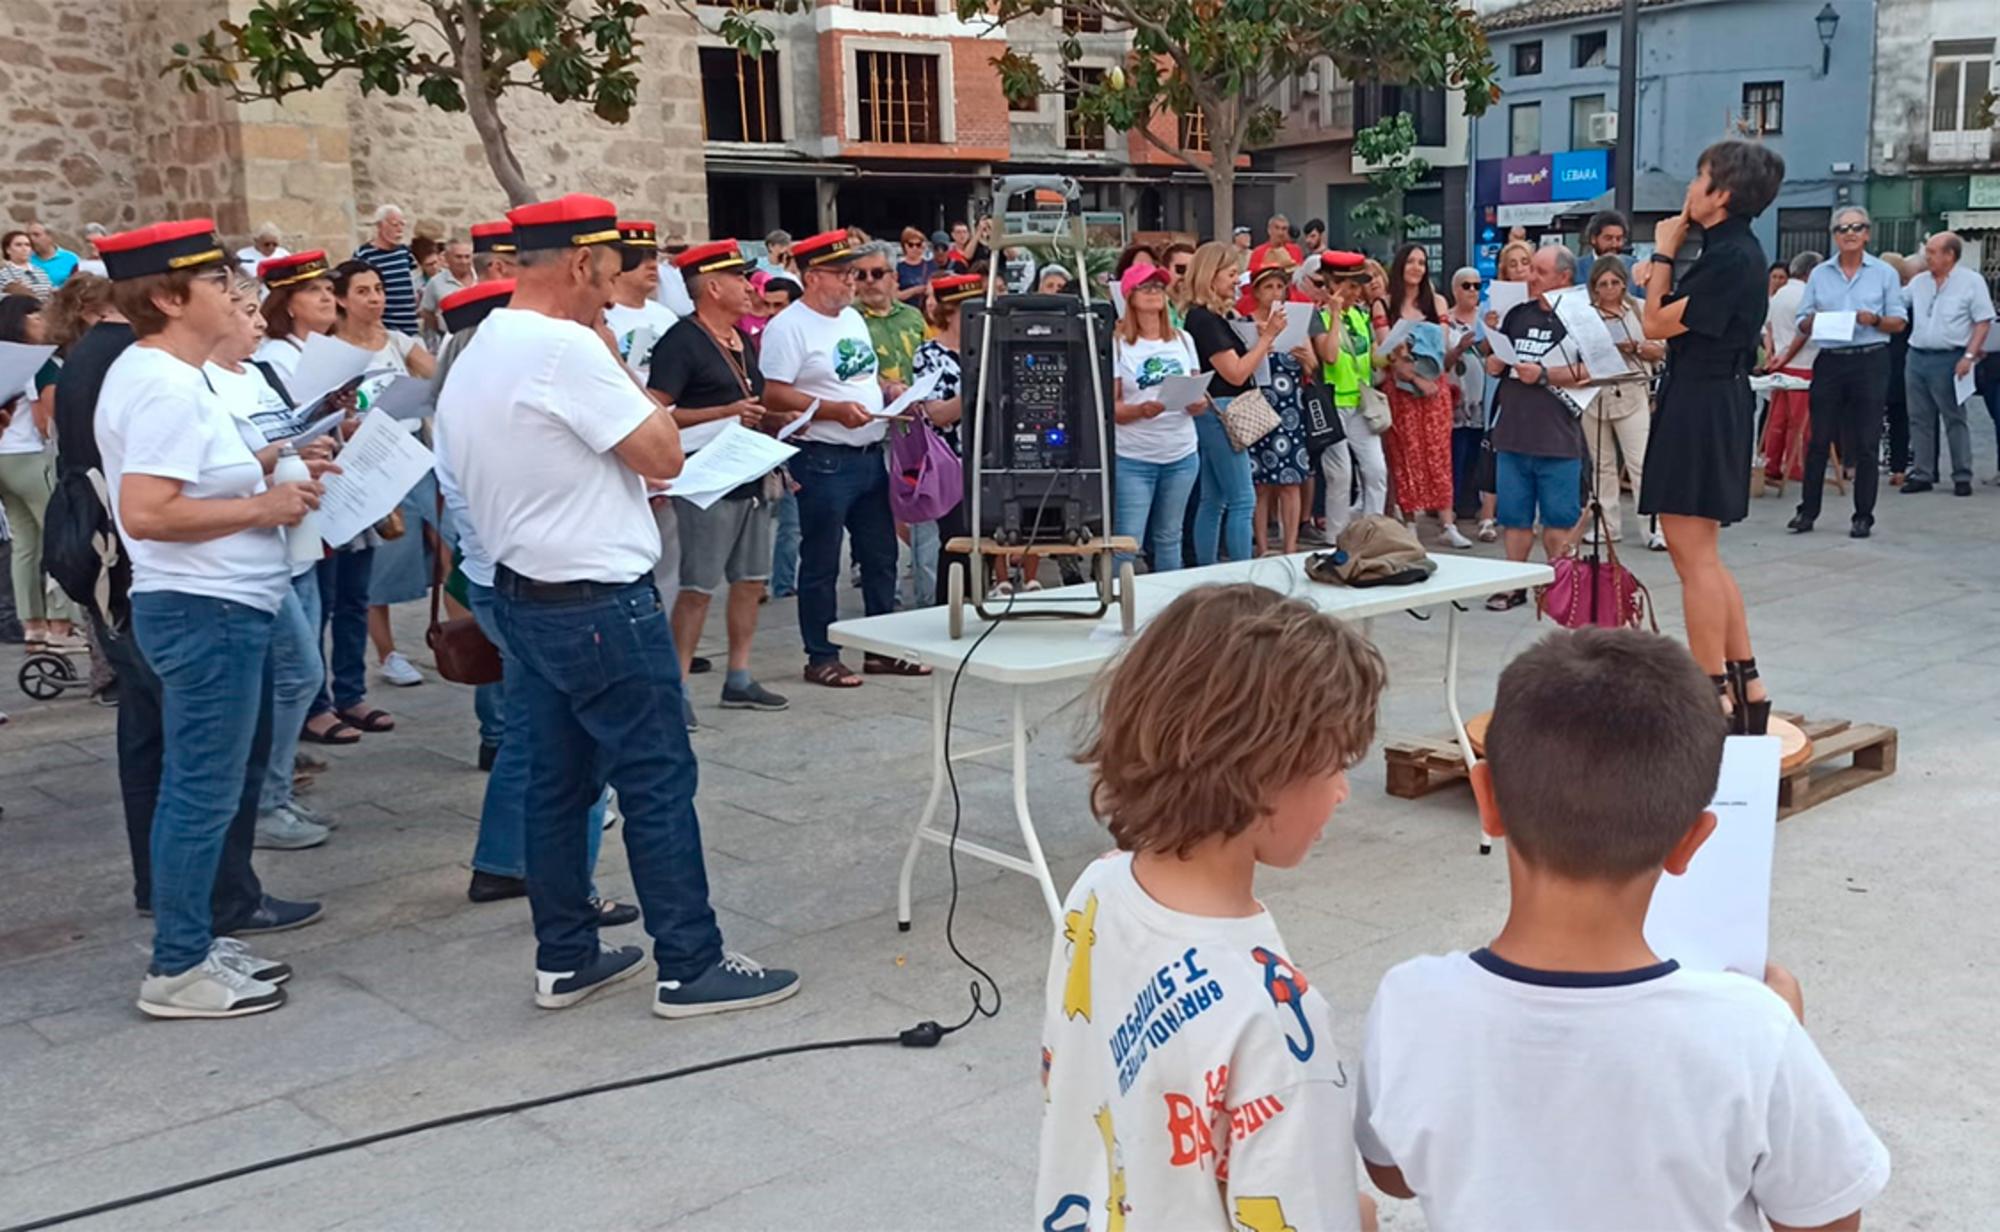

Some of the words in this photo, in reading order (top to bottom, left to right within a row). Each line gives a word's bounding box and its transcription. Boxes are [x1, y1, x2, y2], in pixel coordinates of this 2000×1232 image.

[1561, 167, 1598, 182] LEBARA
[1514, 338, 1554, 355] TIEMP
[1109, 965, 1177, 1068] SIMPSON
